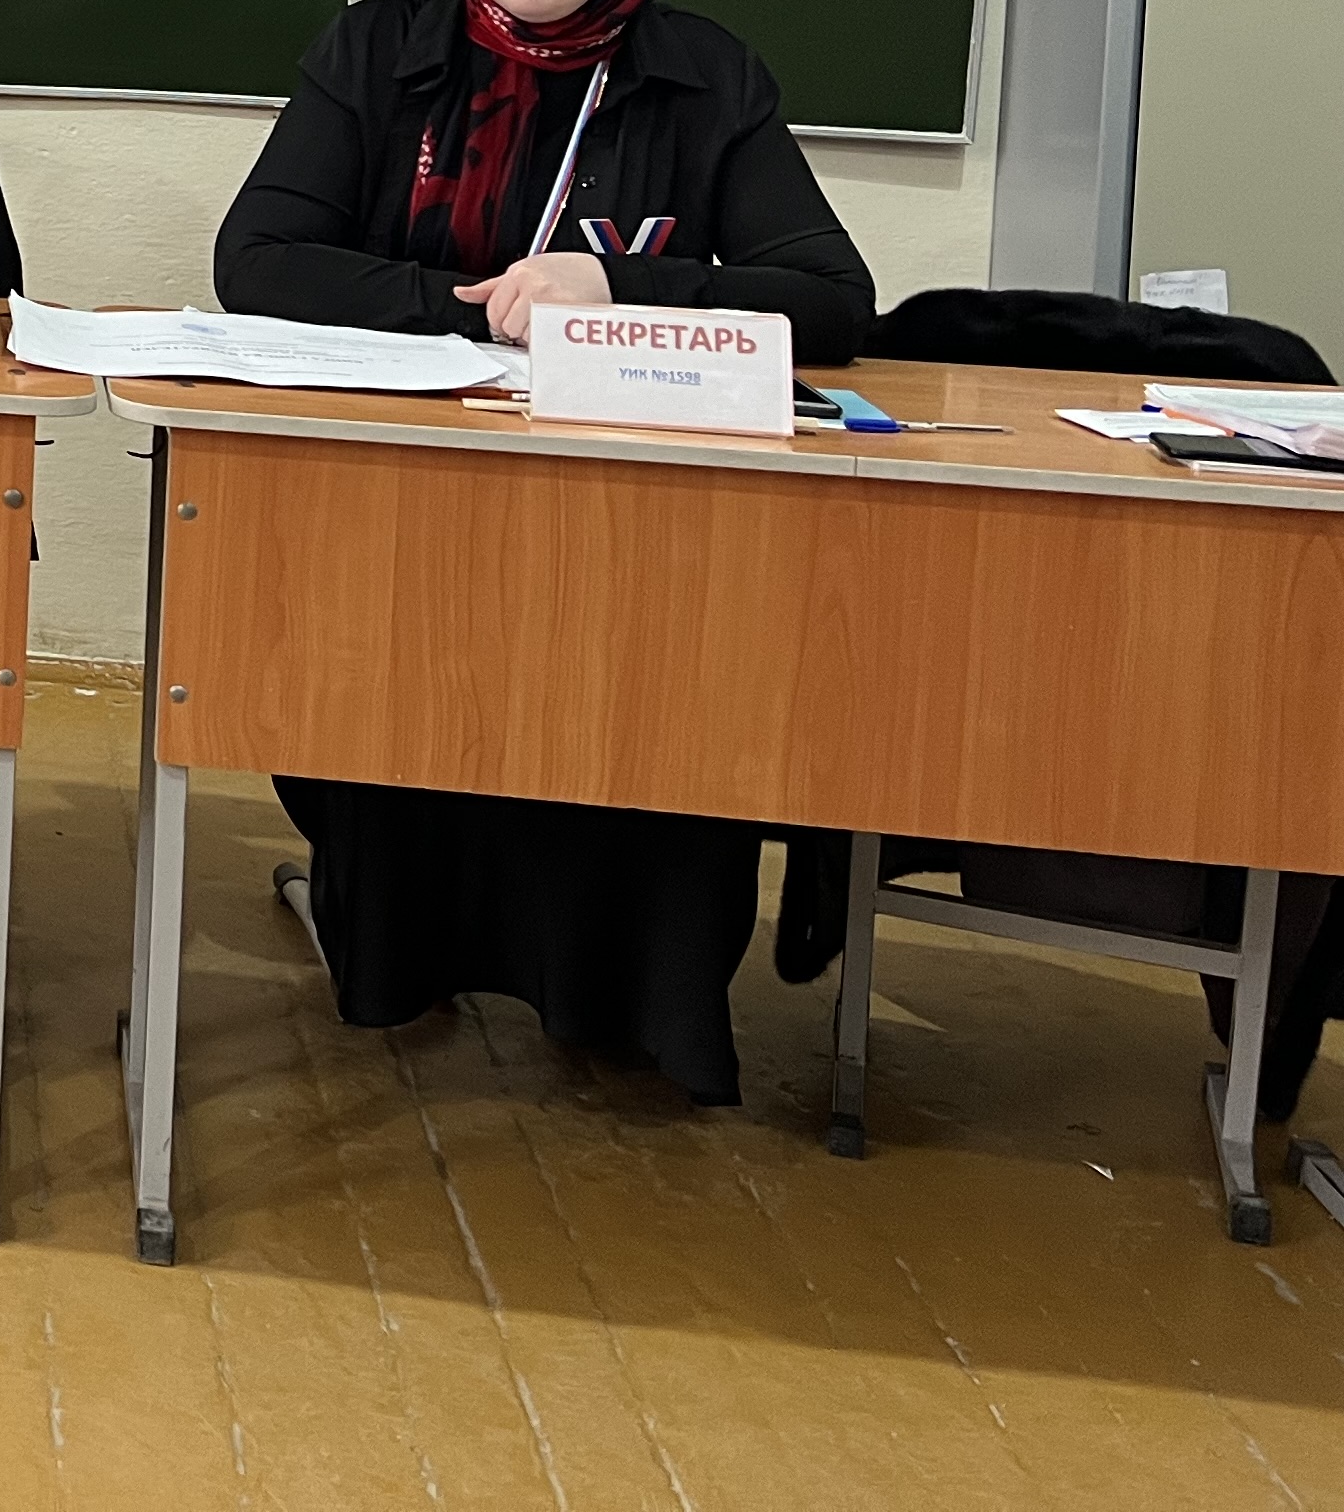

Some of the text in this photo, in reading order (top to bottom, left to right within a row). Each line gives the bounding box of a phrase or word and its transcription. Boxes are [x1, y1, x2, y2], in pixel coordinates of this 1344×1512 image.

[564, 318, 757, 354] СЕКРЕТАРЬ
[619, 368, 701, 386] УИК №1598
